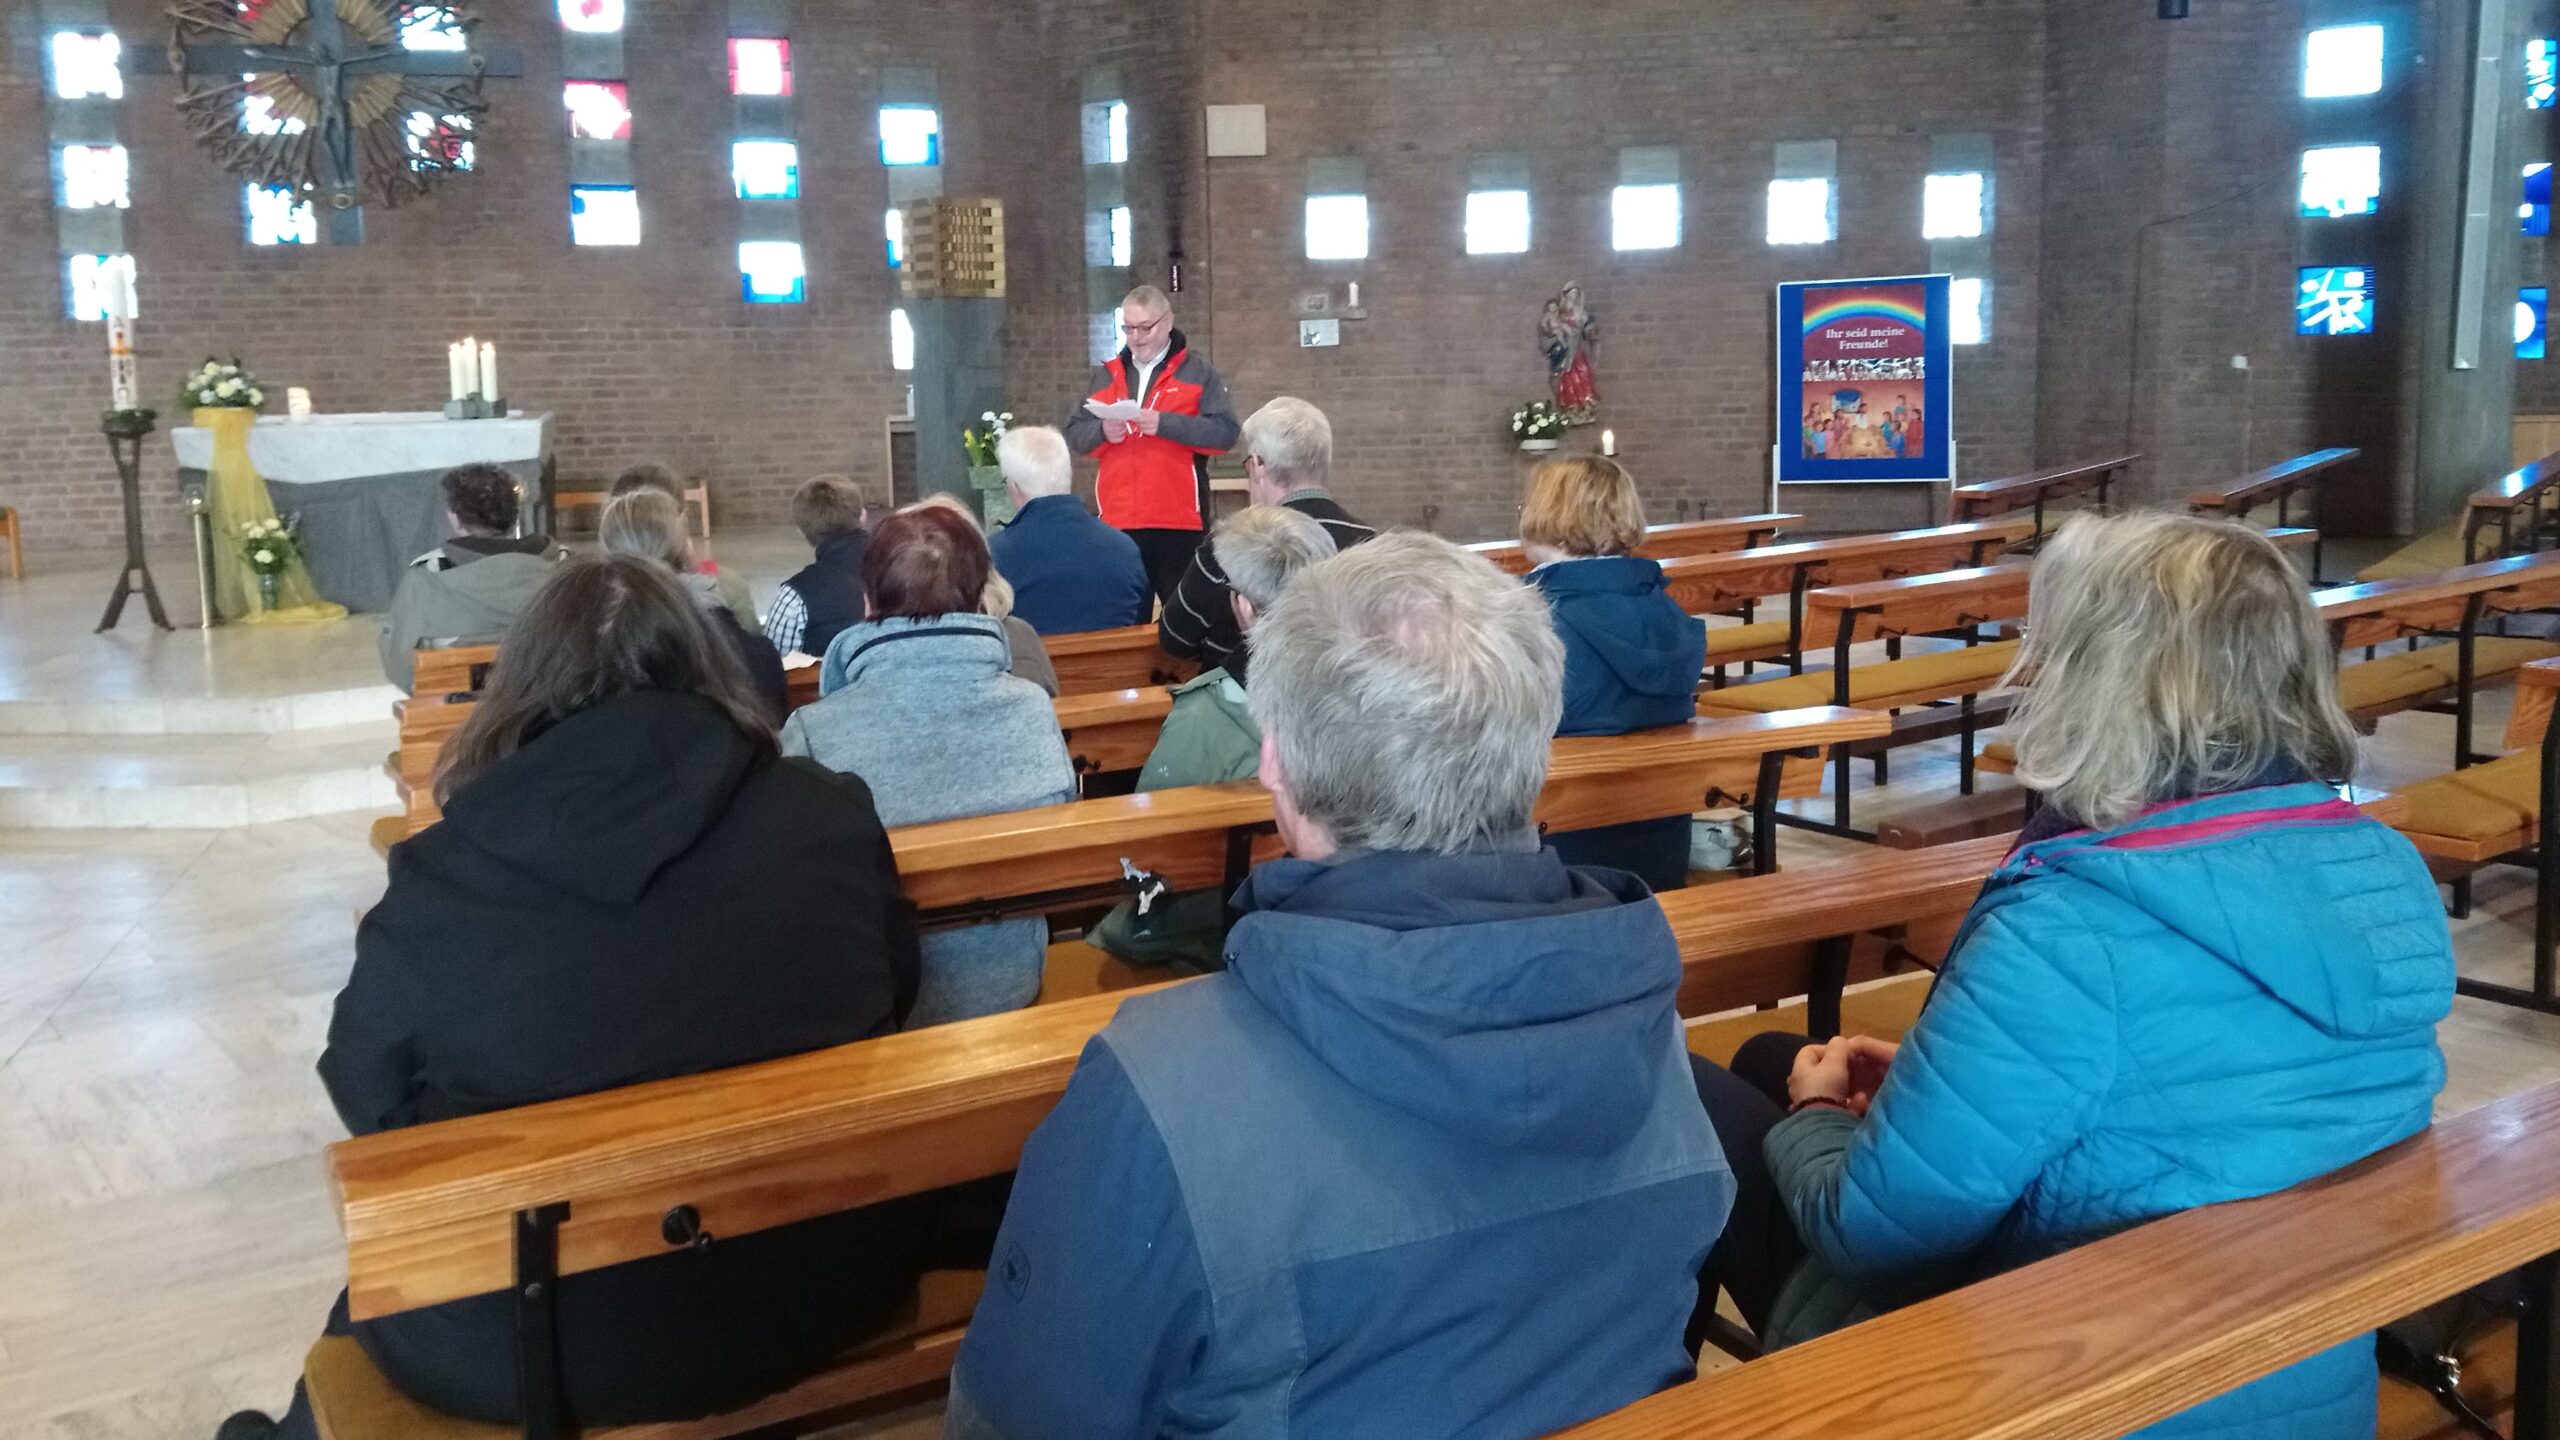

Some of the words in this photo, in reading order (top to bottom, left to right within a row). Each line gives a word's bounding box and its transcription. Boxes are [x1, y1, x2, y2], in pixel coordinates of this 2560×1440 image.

[1826, 328, 1843, 338] Ihr
[1845, 327, 1867, 338] seid
[1870, 327, 1905, 336] meine
[1839, 339, 1888, 349] Freunde!
